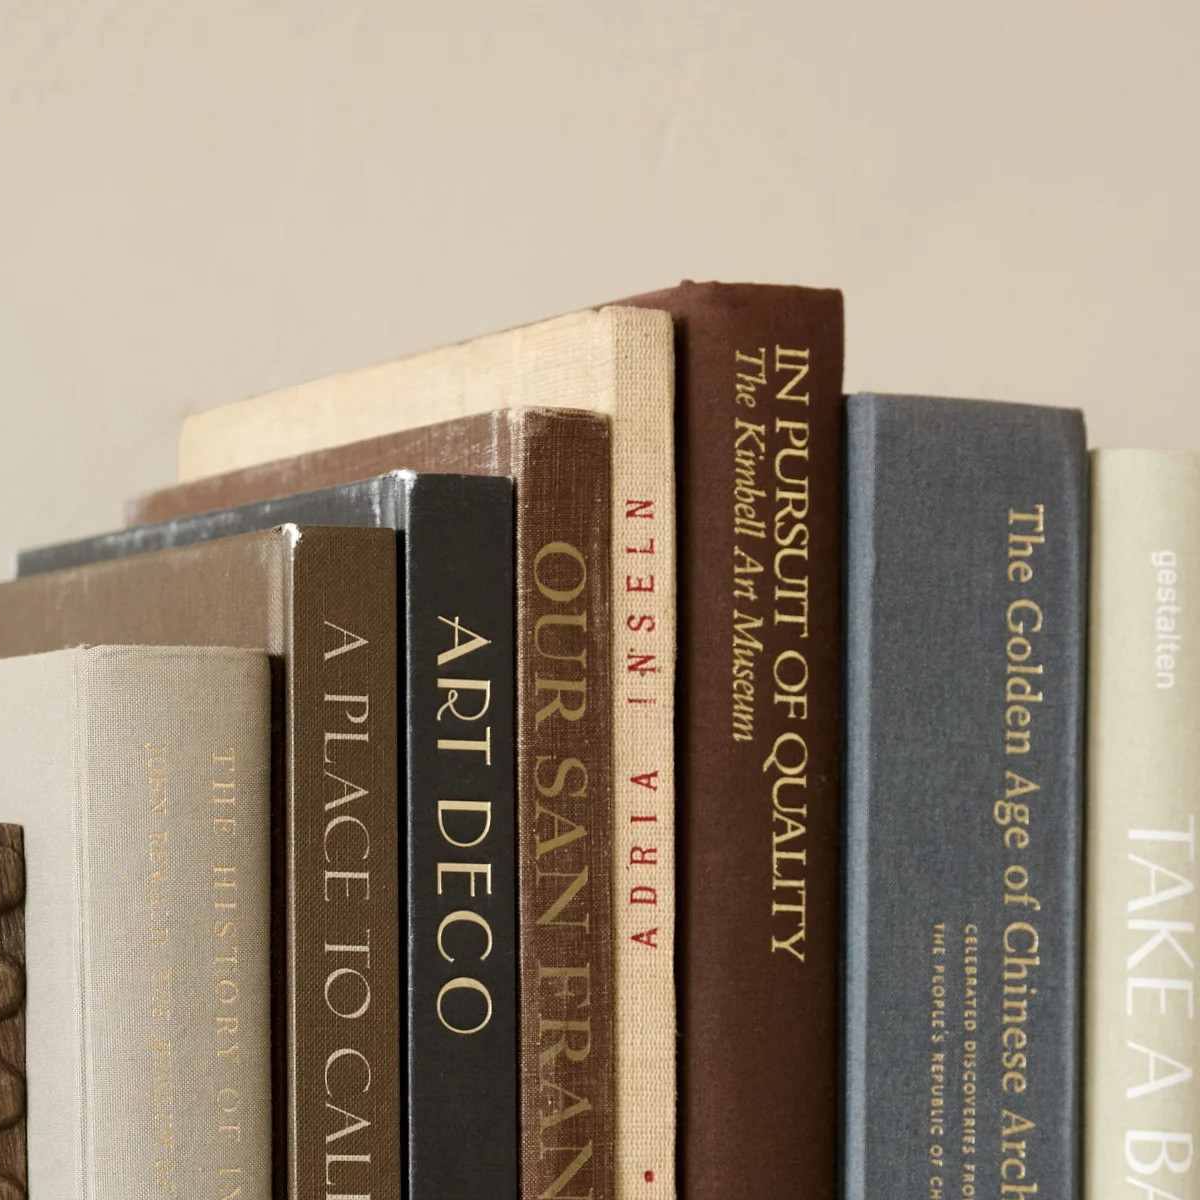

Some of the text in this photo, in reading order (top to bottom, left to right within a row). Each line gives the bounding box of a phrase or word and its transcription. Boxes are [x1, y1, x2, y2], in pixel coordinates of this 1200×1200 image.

[730, 346, 766, 742] The Kimbell Art Museum
[1007, 504, 1045, 583] The
[324, 620, 369, 662] A
[532, 540, 589, 730] OUR
[762, 343, 810, 963] IN PURSUIT OF QUALITY
[1150, 549, 1182, 690] gestalten
[624, 499, 660, 951] ADRIA INSELN
[1004, 599, 1043, 755] Golden
[145, 742, 167, 815] JOHN
[211, 746, 237, 836] THE
[323, 691, 370, 901] PLACE
[435, 616, 493, 1034] ART DECO
[994, 771, 1040, 849] Age
[149, 831, 169, 945] REWALD
[534, 755, 591, 932] SAN
[1003, 864, 1040, 911] of
[212, 864, 240, 1063] HISTORY
[933, 923, 945, 954] THE
[1125, 818, 1195, 1017] TAKE
[324, 929, 371, 1019] TO
[931, 964, 949, 1043] PEOPLE'S
[963, 923, 977, 1032] CELEBRATED
[1001, 921, 1039, 1093] Chinese
[214, 1087, 241, 1143] OF
[930, 1053, 945, 1135] REPUBLIC
[962, 1040, 976, 1154] DISCOVERIES
[1124, 1040, 1194, 1100] A
[930, 1144, 943, 1167] OF
